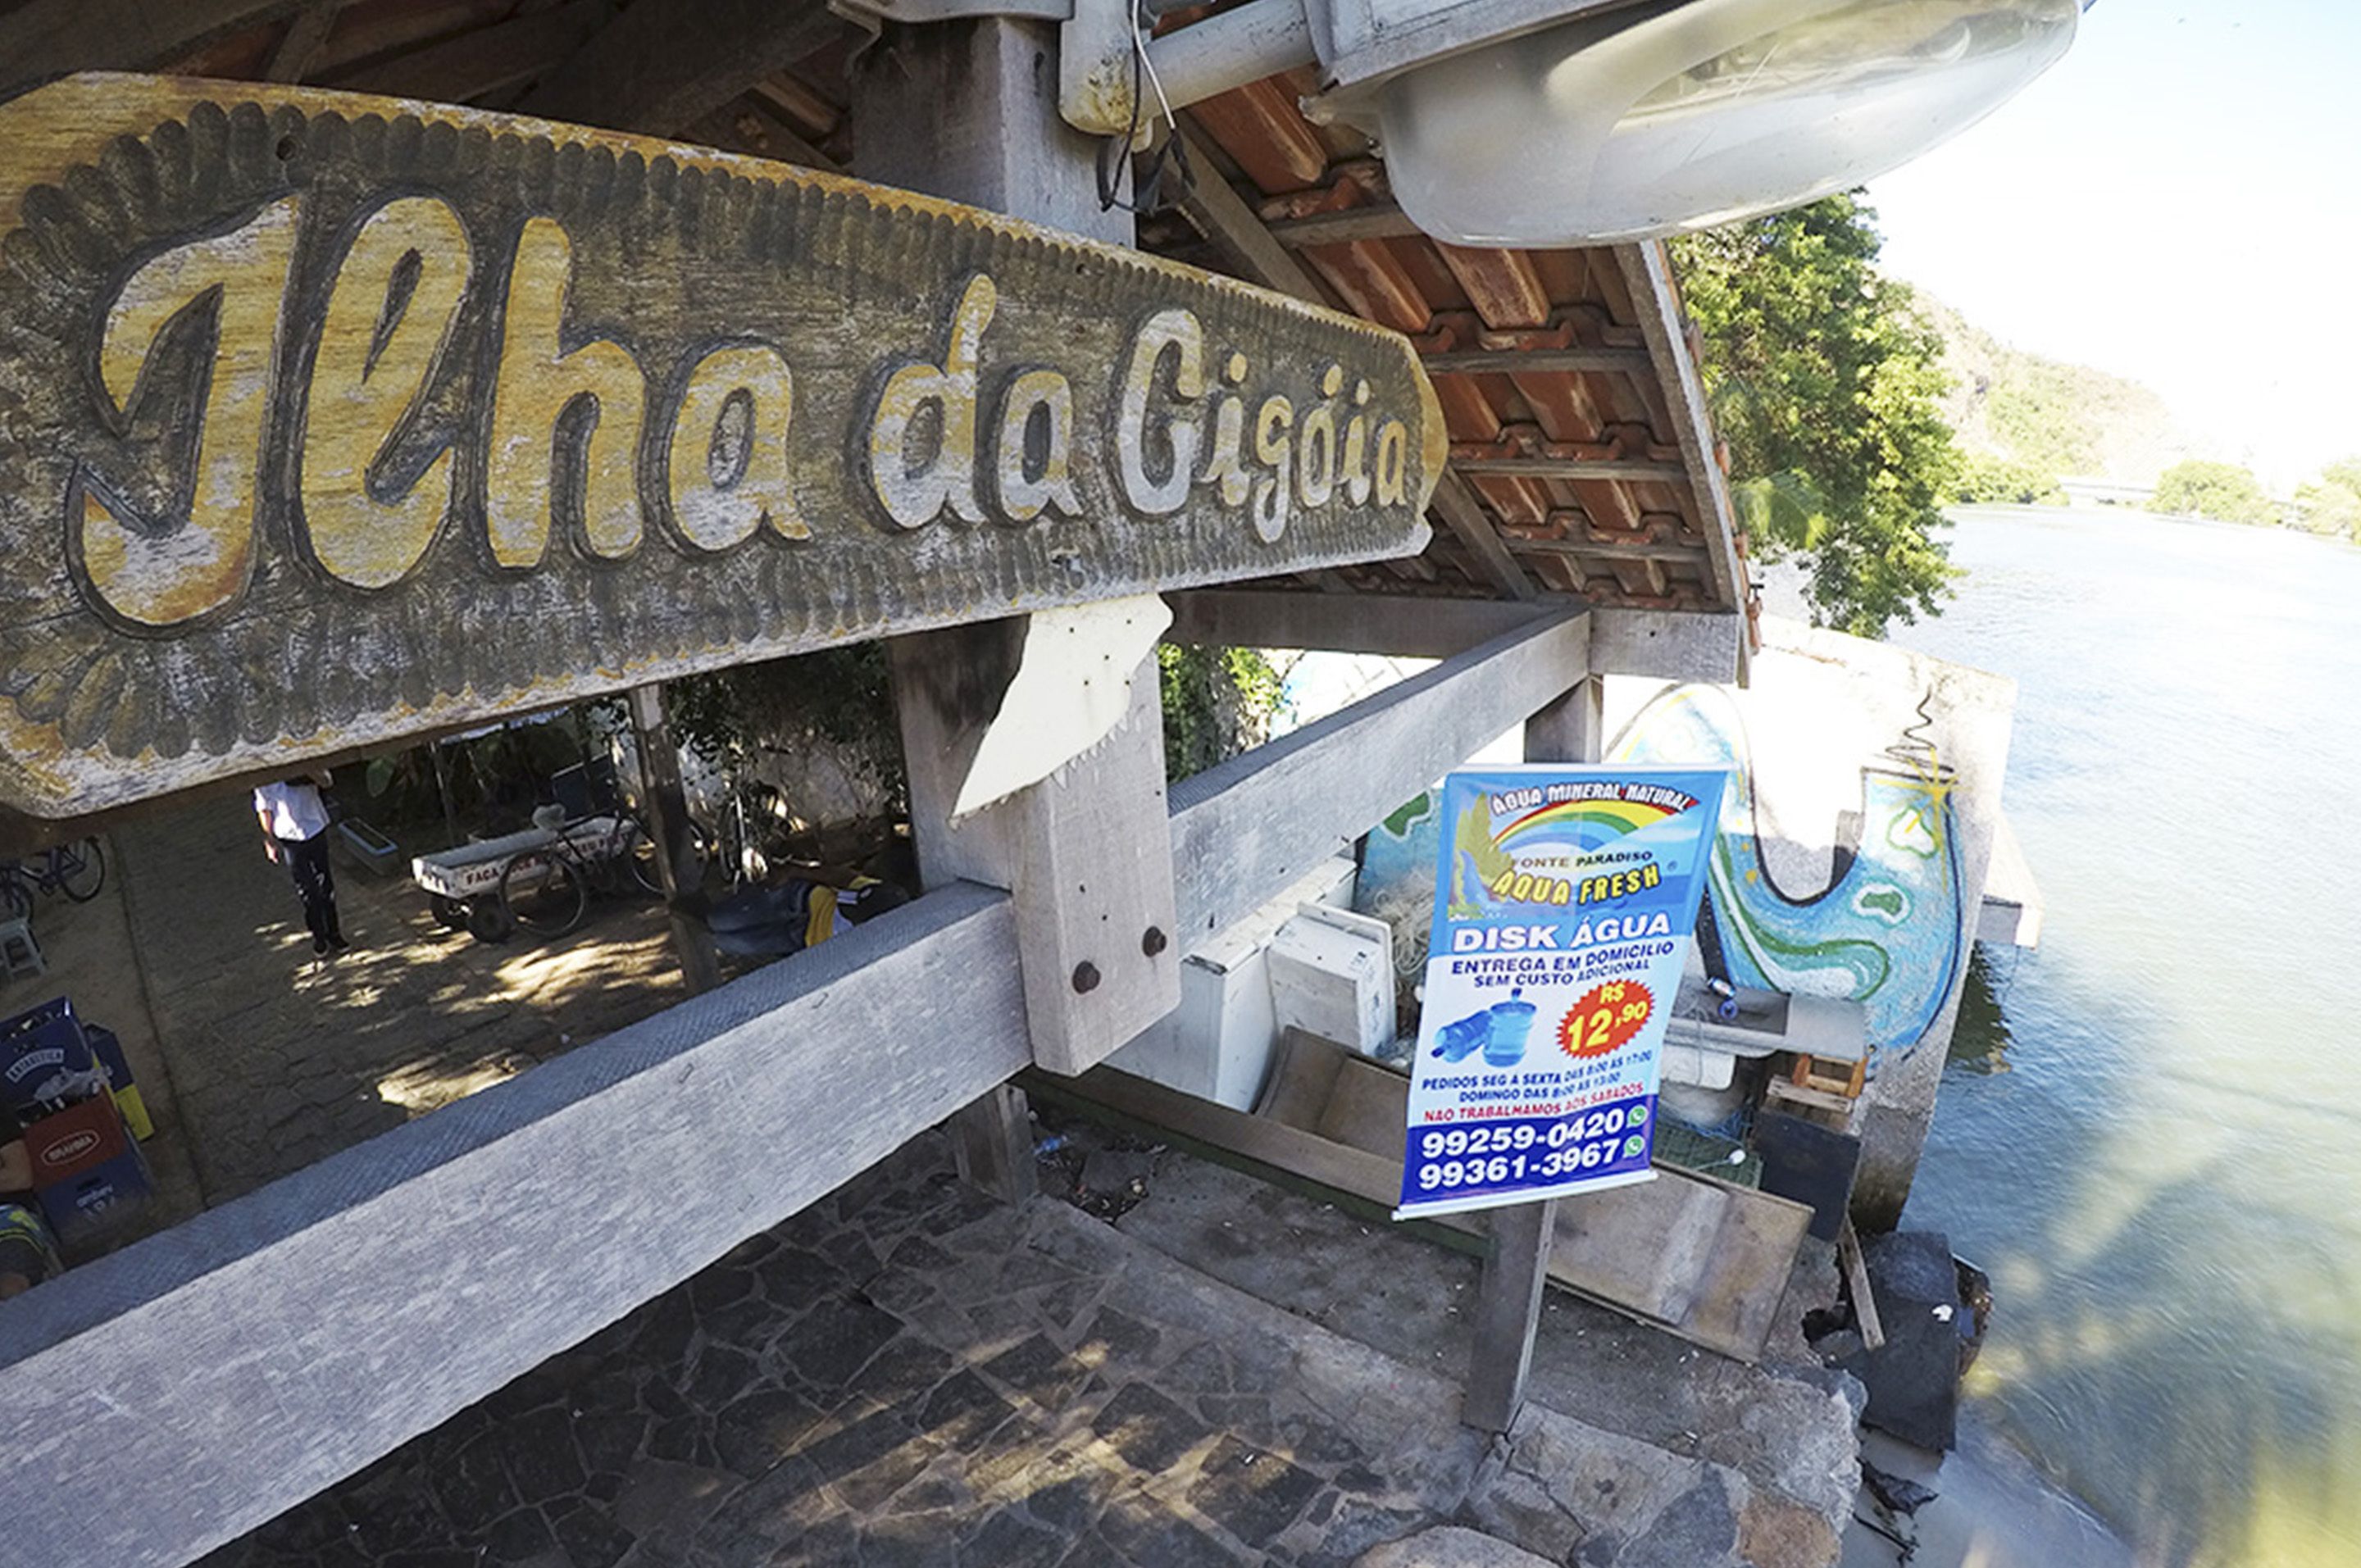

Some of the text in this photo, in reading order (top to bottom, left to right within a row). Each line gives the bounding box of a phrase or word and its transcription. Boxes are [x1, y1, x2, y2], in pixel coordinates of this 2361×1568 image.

[83, 194, 812, 625] Ilha
[871, 273, 1082, 529] da
[1547, 784, 1621, 802] MINERAL
[1626, 784, 1691, 811] NATURAL
[1576, 851, 1653, 867] PARADISO
[1492, 864, 1659, 905] AQUA FRESH
[1453, 913, 1671, 952] DISK ÁGUA
[1452, 957, 1545, 975] ENTREGA
[1554, 957, 1581, 971] EM
[1475, 959, 1650, 988] SEM CUSTO ADICIONAL
[1600, 984, 1625, 1004] R$
[1567, 1001, 1648, 1052] 12,90
[1422, 1078, 1477, 1090] PEDIDOS
[1482, 1075, 1506, 1087] SEG
[1522, 1072, 1560, 1085] SEXTA
[1459, 1090, 1520, 1102] DOMINGO
[1523, 1088, 1548, 1099] DAS
[1459, 1103, 1561, 1120] TRABALHAMOS
[1422, 1108, 1624, 1158] 99259-0420
[1419, 1139, 1621, 1191] 99361-3967
